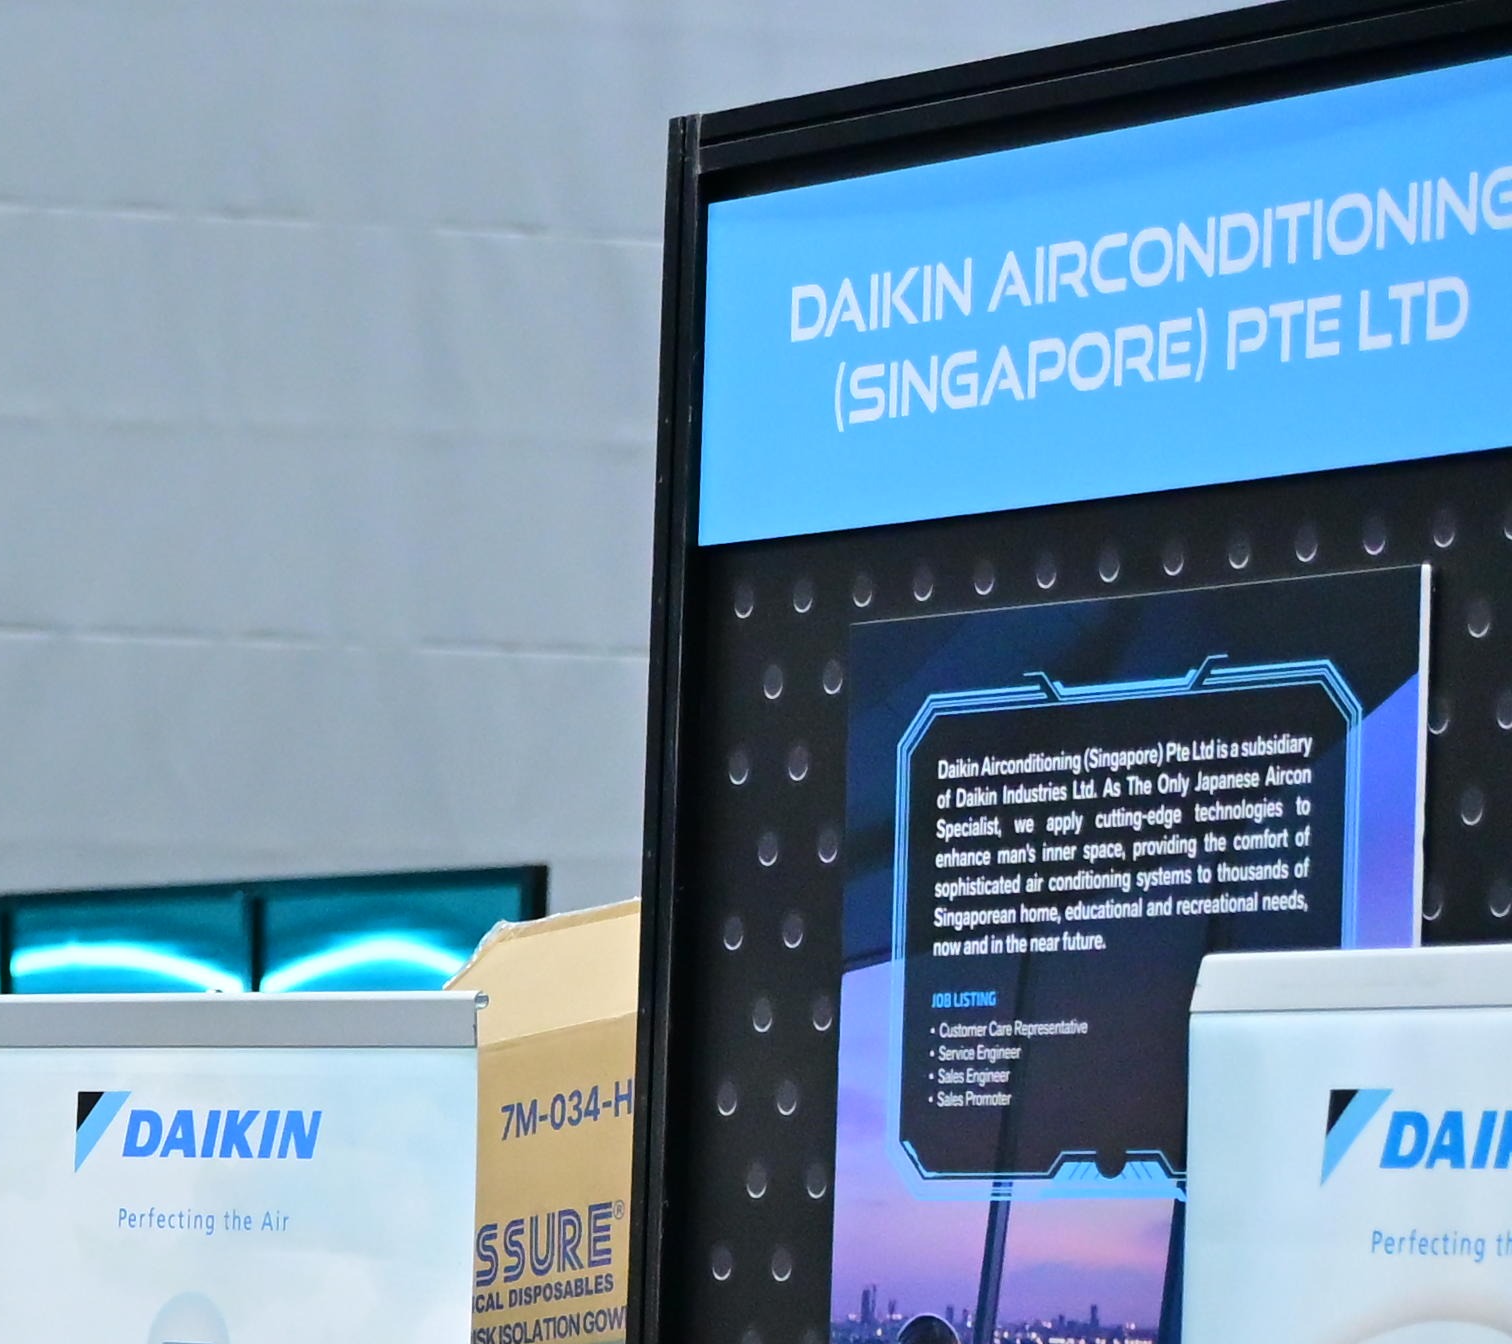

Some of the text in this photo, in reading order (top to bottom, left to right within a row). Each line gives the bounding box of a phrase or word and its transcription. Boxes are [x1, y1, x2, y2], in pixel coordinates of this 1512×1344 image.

[790, 166, 1512, 342] DAIKIN AIRCONDITIONING
[834, 276, 1469, 432] (SINGAPORE) PTE LTD
[937, 734, 1312, 779] Daikin Airconditioning (Singapore) Pte Ltd is a subsidiary
[936, 768, 1311, 809] of Daikin Industries Ltd. As The Only Japanese Aircon
[936, 796, 1311, 842] Specialist, we apply cutting-edge technologies to
[931, 990, 996, 1008] JOB LISTING
[939, 1019, 1088, 1038] Customer Care Representative
[500, 1078, 633, 1141] 7M-034-H
[121, 1110, 320, 1159] DAIKIN
[117, 1207, 290, 1236] Perfecting the Air
[474, 1202, 613, 1288] SSURE
[1372, 1230, 1485, 1262] Perfecting
[471, 1291, 504, 1314] ICAL
[584, 1306, 627, 1333] GOW
